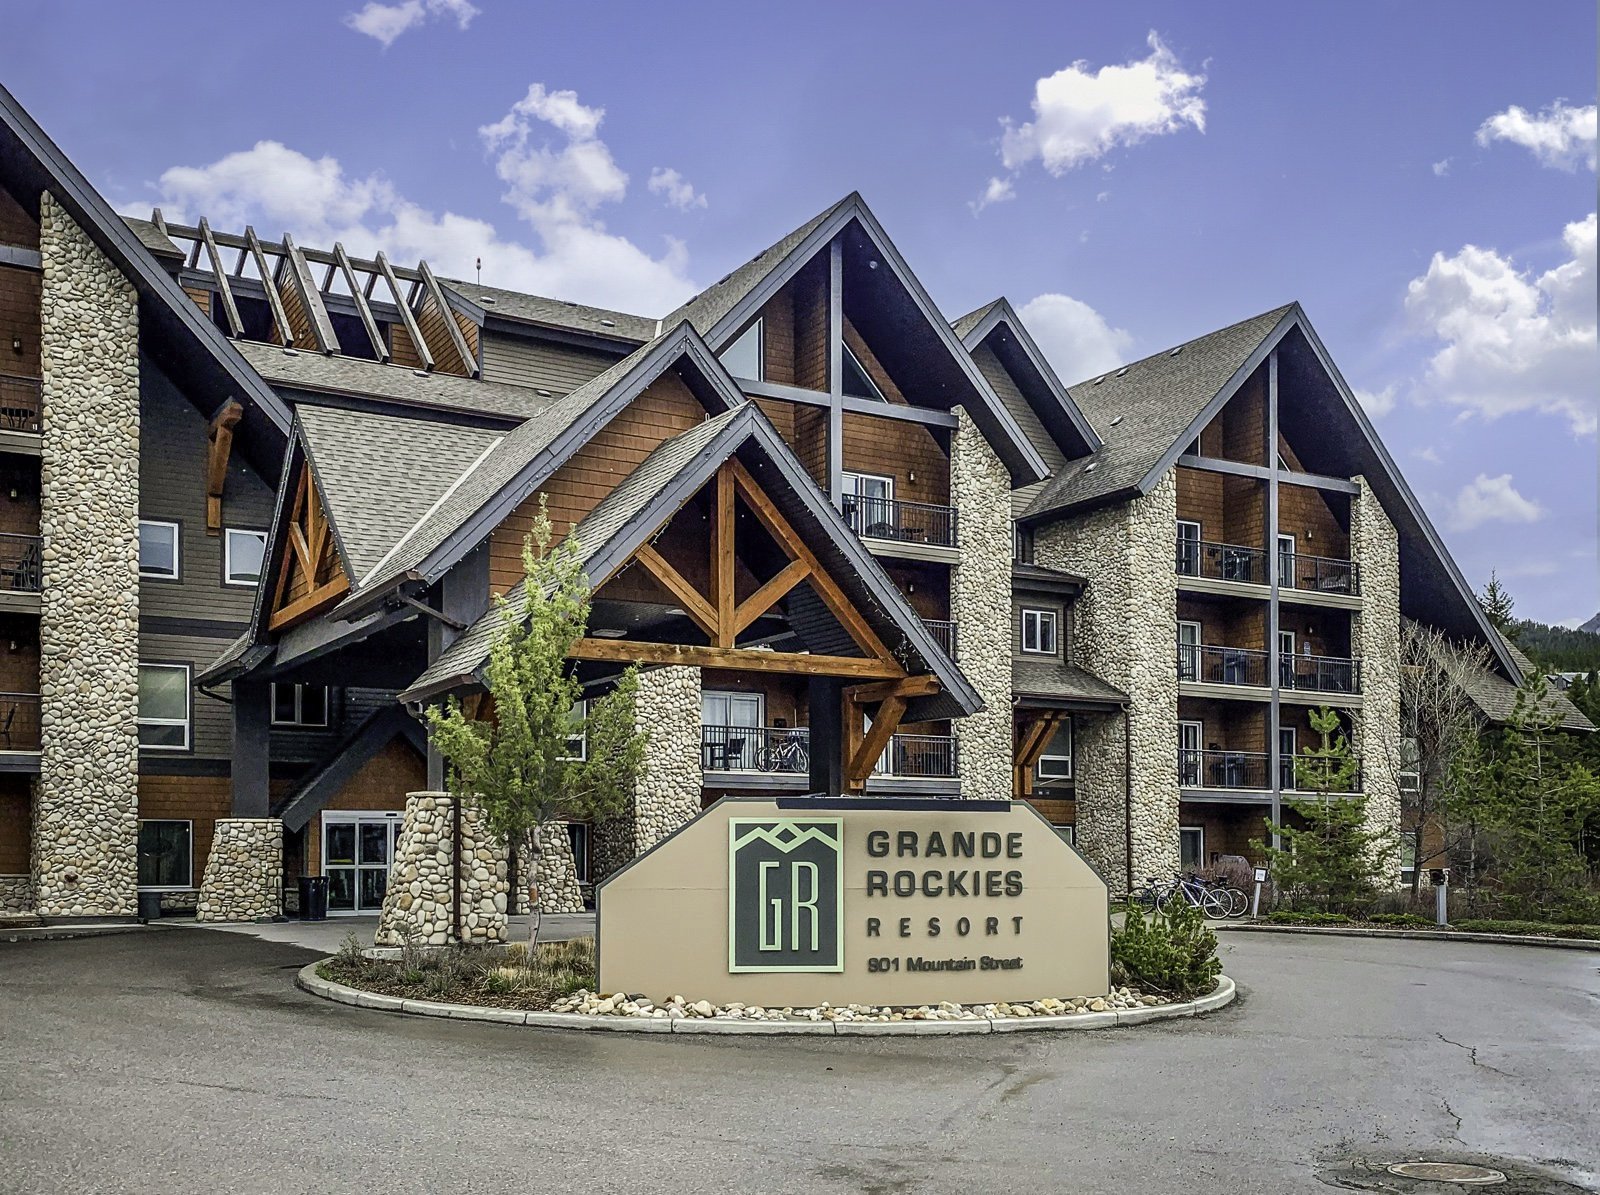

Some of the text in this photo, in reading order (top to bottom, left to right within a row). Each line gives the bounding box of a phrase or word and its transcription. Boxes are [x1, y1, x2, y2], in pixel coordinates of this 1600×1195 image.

[867, 830, 1023, 858] GRANDE
[867, 870, 1023, 897] ROCKIES
[759, 861, 819, 951] GR
[867, 916, 1023, 937] RESORT
[907, 956, 976, 972] Mountain
[980, 955, 1023, 970] Street
